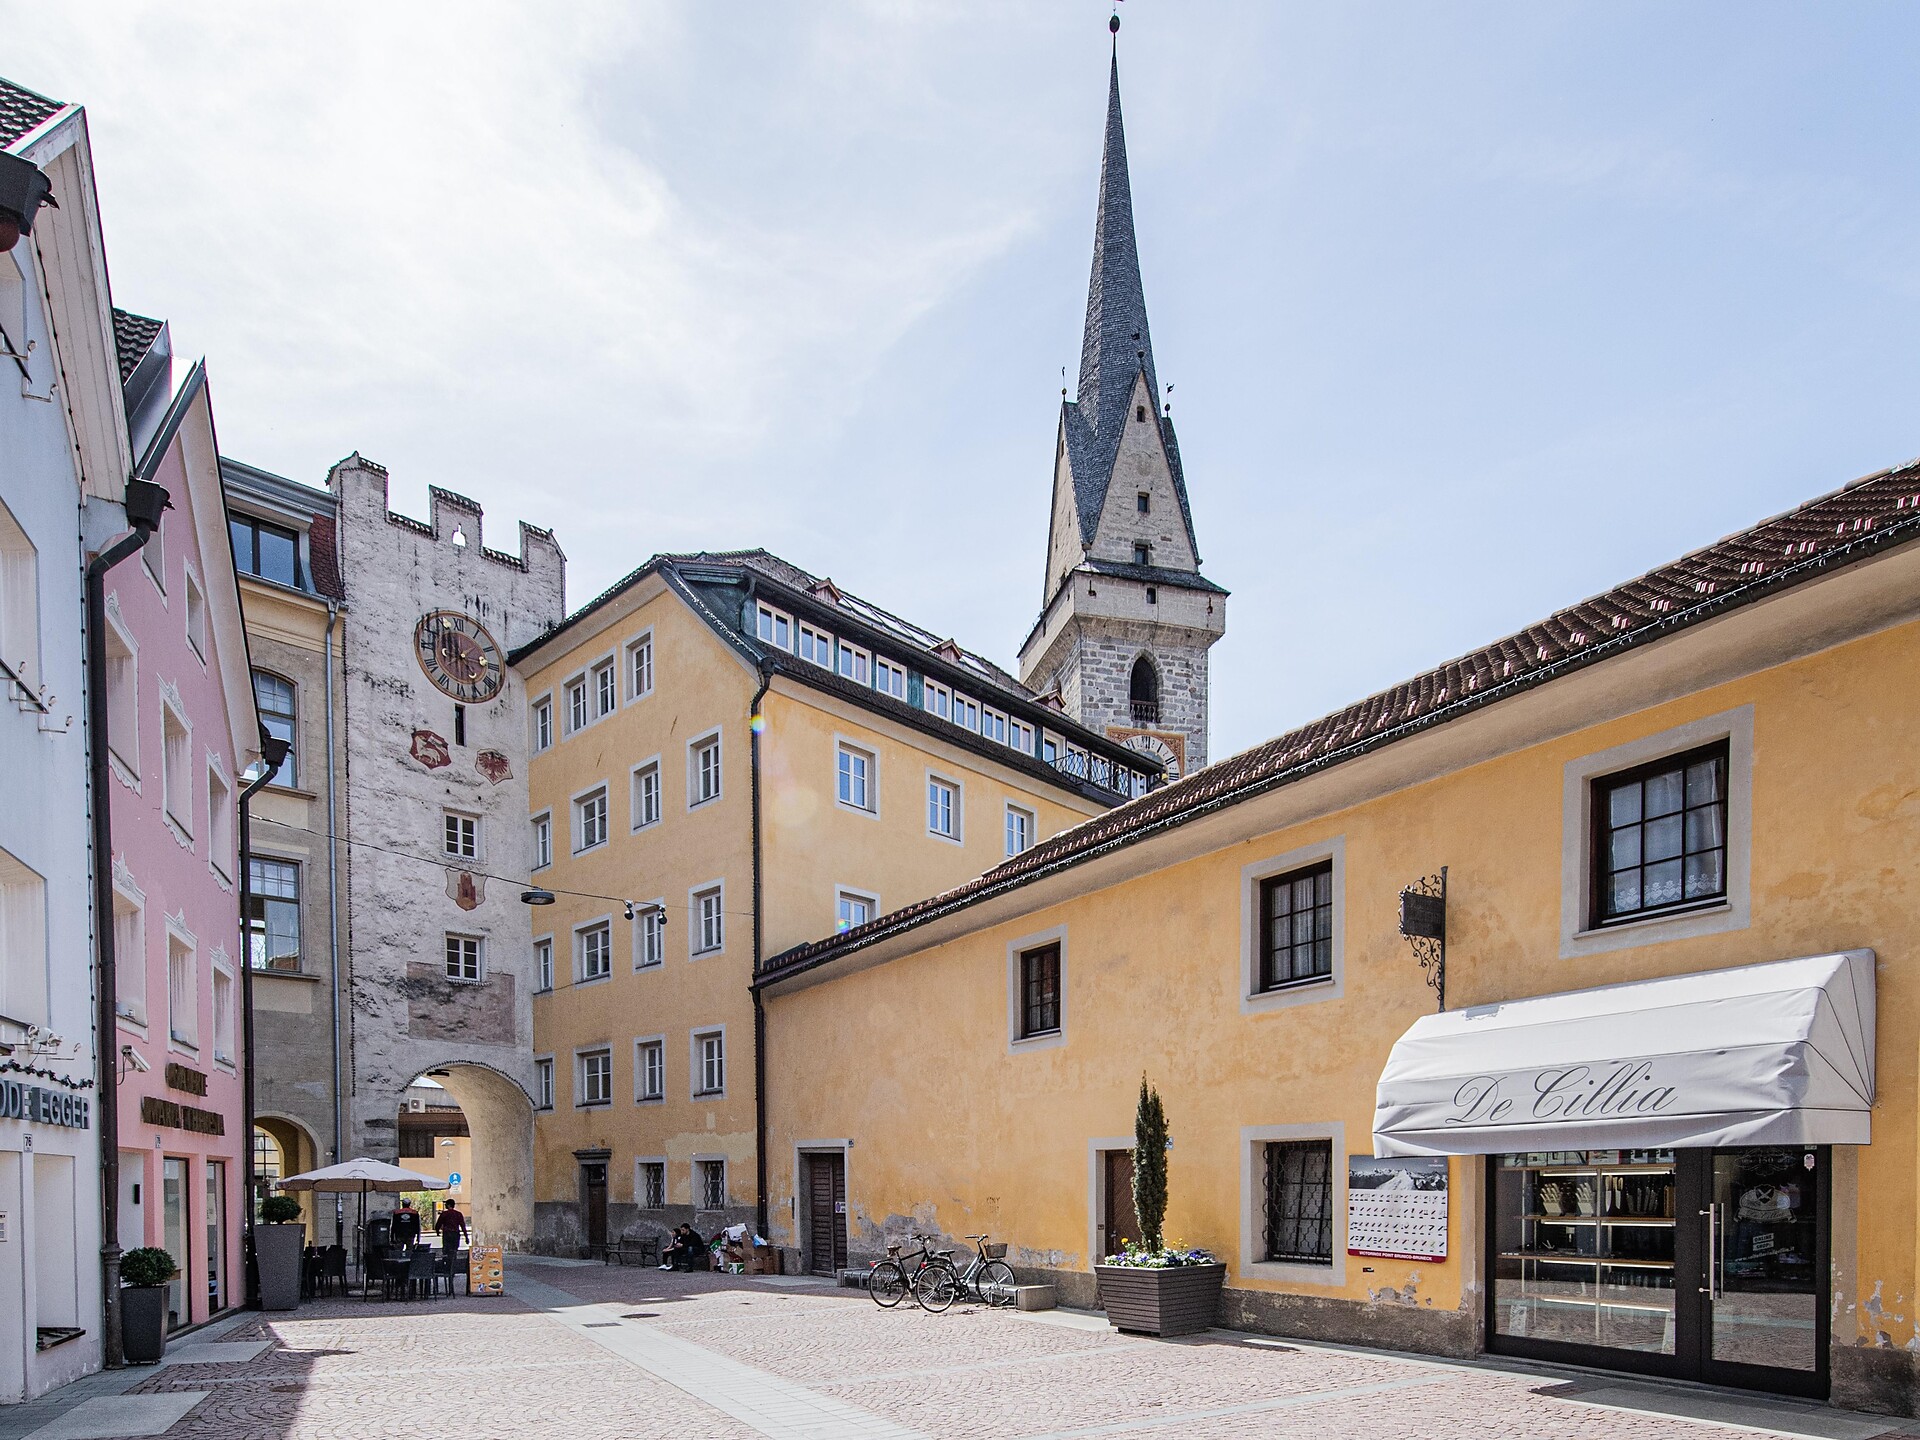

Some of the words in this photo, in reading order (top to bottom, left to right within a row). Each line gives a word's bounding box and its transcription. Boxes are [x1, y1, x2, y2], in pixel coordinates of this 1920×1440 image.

[37, 1086, 90, 1129] EGGER
[1445, 1075, 1515, 1124] De
[1531, 1061, 1678, 1119] Cillia
